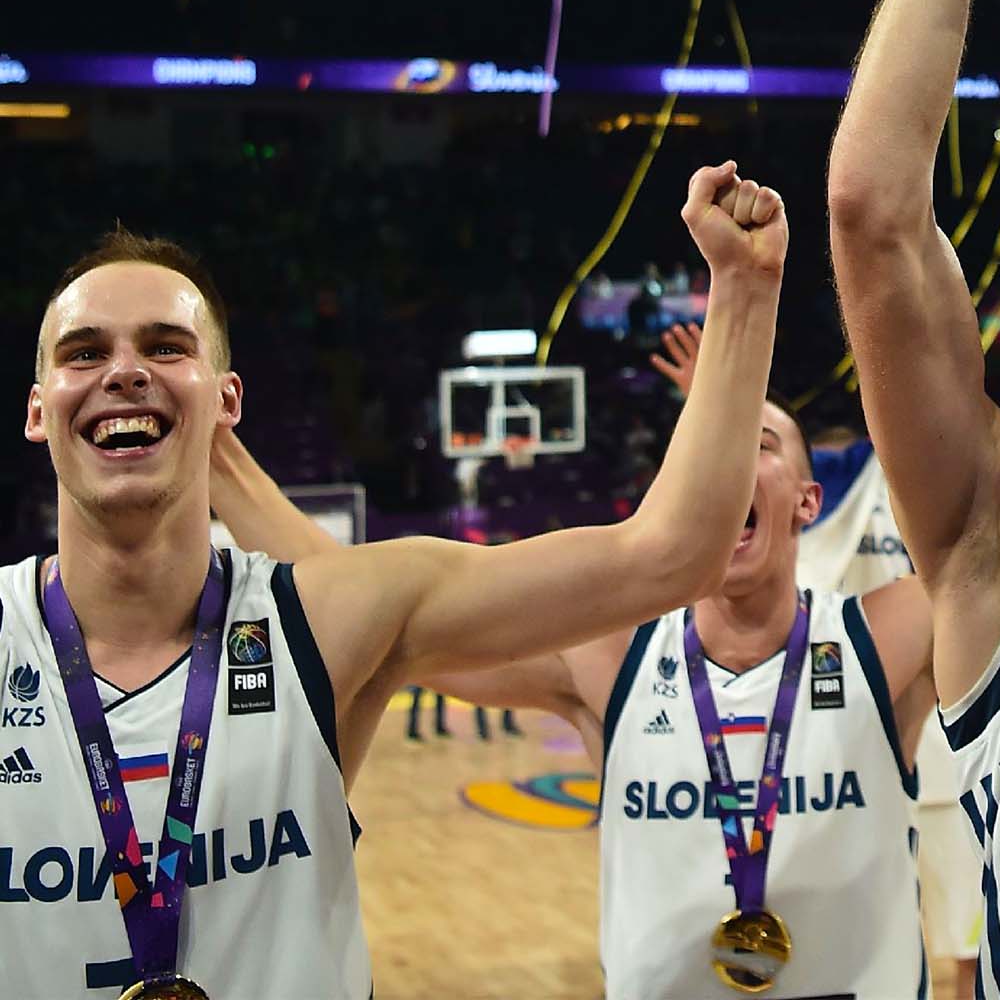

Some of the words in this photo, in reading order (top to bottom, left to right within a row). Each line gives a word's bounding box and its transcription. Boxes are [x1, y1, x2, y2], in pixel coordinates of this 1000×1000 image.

[234, 672, 267, 690] FIBA
[814, 678, 841, 694] FIBA
[2, 706, 47, 728] KZS
[0, 768, 42, 785] didas
[623, 770, 866, 820] SLOEIJA
[0, 809, 312, 903] LONIJA
